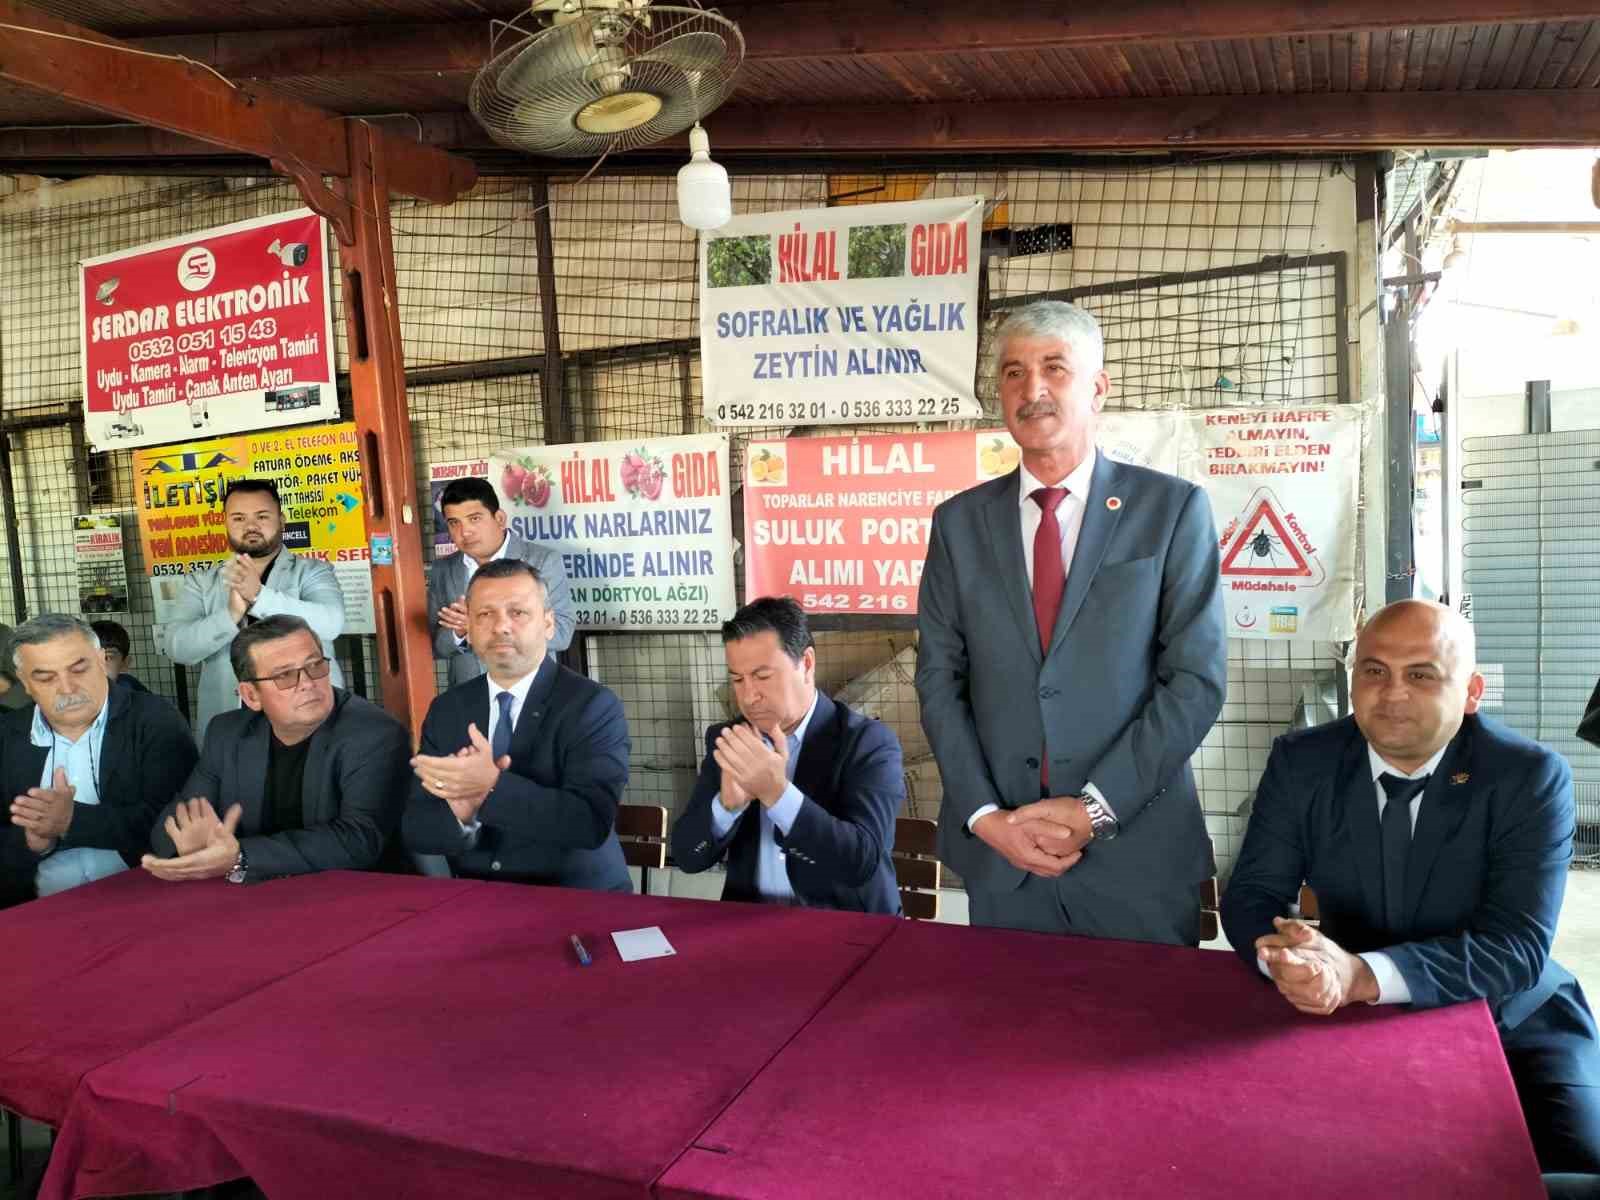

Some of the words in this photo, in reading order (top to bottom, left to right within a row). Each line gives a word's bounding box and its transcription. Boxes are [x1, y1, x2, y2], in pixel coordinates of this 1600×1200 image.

[777, 222, 840, 283] HİLAL
[911, 222, 968, 277] GIDA
[92, 305, 170, 342] SERDAR
[175, 271, 310, 327] ELEKTRONİK
[716, 307, 829, 339] SOFRALIK
[837, 305, 867, 333] VE
[872, 298, 967, 333] YAĞLIK
[129, 338, 174, 362] 0532
[177, 330, 215, 352] 051
[220, 323, 245, 346] 15
[249, 318, 276, 340] 48
[97, 369, 123, 392] Uydu
[130, 363, 172, 384] Kamera
[179, 355, 209, 375] Alarm
[219, 343, 278, 370] Televizyon
[280, 333, 319, 355] Tamiri
[753, 344, 838, 380] ZEYTİN
[846, 347, 928, 376] ALINIR
[112, 391, 140, 415] Uydu
[141, 384, 177, 407] Tamiri
[186, 377, 222, 405] Çanak
[223, 372, 258, 395] Anten
[260, 367, 293, 392] Ayarı
[718, 405, 726, 420] 0
[729, 404, 755, 420] 542
[759, 403, 784, 419] 216
[789, 402, 809, 419] 32
[810, 402, 827, 419] 01
[840, 402, 849, 418] 0
[854, 401, 880, 418] 536
[885, 400, 912, 417] 333
[918, 398, 936, 415] 22
[941, 398, 960, 415] 25
[285, 439, 295, 450] EL
[297, 433, 336, 448] TELEFON
[254, 458, 291, 473] FATURA
[822, 437, 935, 476] HİLAL
[143, 472, 246, 510] İLETİŞİ
[306, 471, 338, 486] PAKET
[560, 451, 616, 504] HİLAL
[671, 450, 721, 498] GIDA
[288, 504, 338, 520] Telekom
[763, 492, 833, 508] TOPARLAR
[838, 488, 920, 507] NARENCİYE
[511, 513, 578, 540] SULUK
[584, 508, 713, 539] NARLARINIZ
[753, 518, 845, 545] SULUK
[1284, 512, 1317, 555] Kontrol
[153, 563, 184, 577] 0532
[562, 548, 636, 579] ERİNDE
[642, 550, 714, 577] ALINIR
[789, 560, 864, 585] ALIMI
[592, 584, 662, 603] DÖRTYOL
[666, 580, 709, 605] AĞZI)
[1232, 581, 1297, 592] Müdahale
[803, 594, 850, 609] 542
[858, 594, 908, 609] 216
[575, 609, 590, 625] 32
[593, 609, 607, 625] 01
[619, 610, 626, 625] 0
[630, 609, 653, 625] 536
[656, 609, 679, 624] 333
[683, 608, 699, 624] 22
[703, 608, 719, 624] 25
